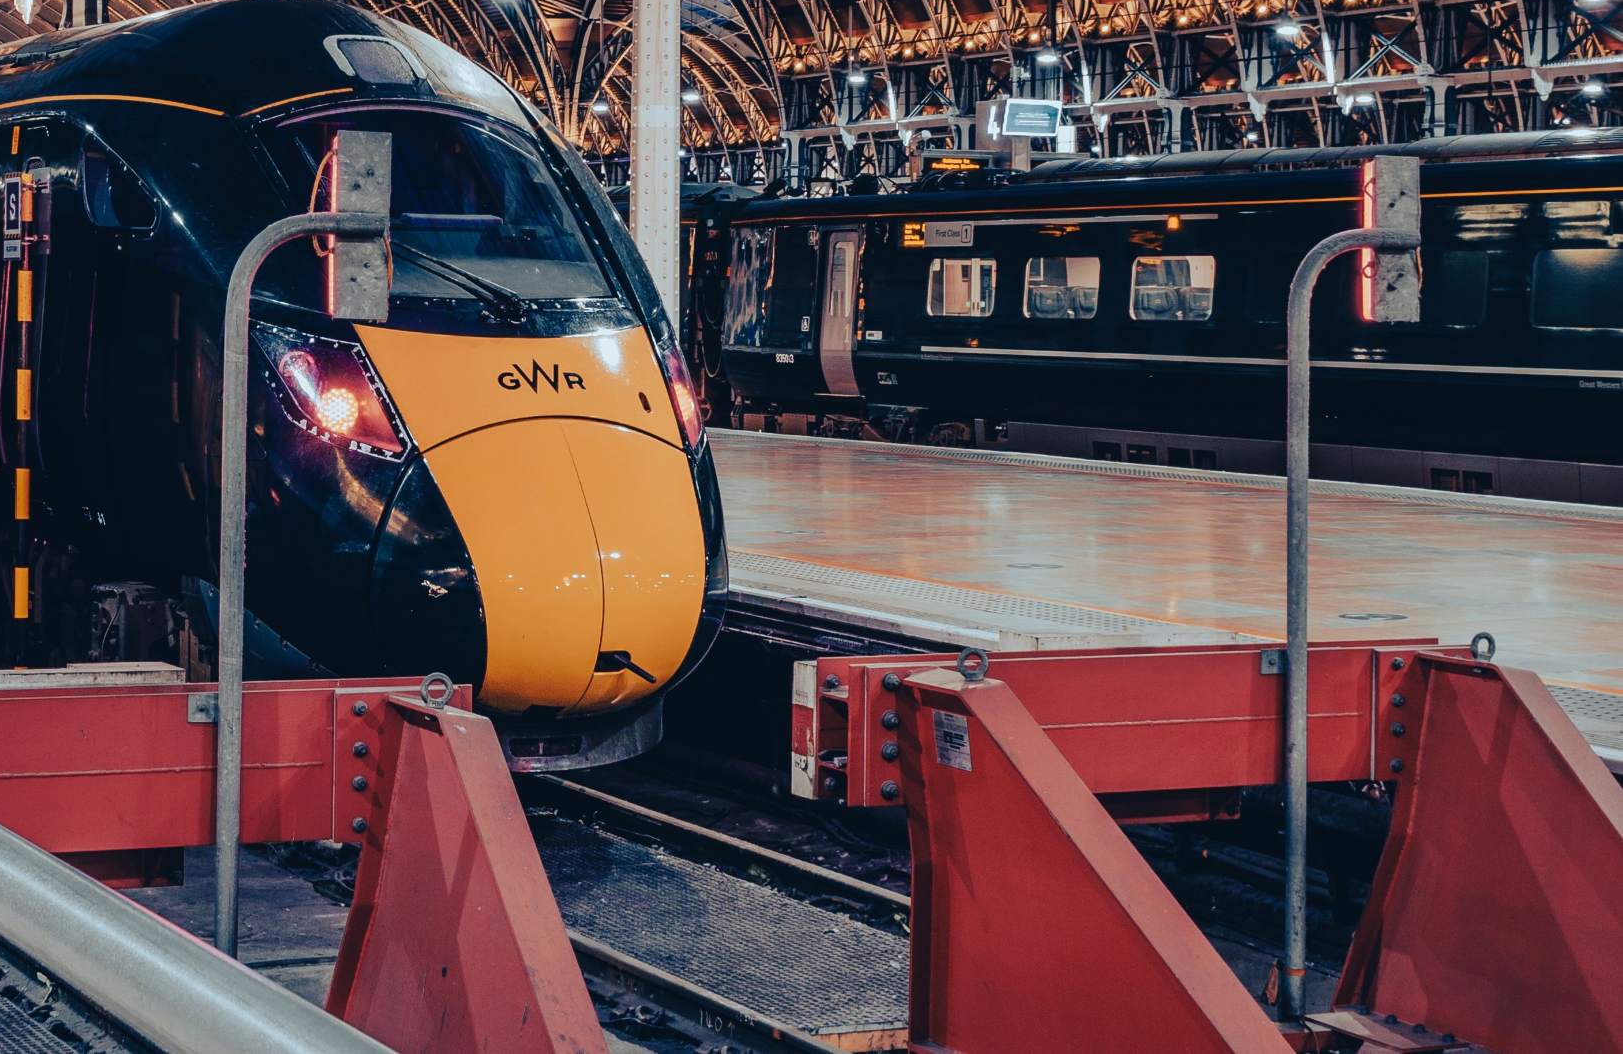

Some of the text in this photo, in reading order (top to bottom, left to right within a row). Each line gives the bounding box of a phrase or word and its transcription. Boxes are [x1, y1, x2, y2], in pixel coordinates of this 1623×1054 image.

[987, 105, 1001, 141] 4
[9, 193, 17, 221] S
[497, 357, 587, 395] GWR
